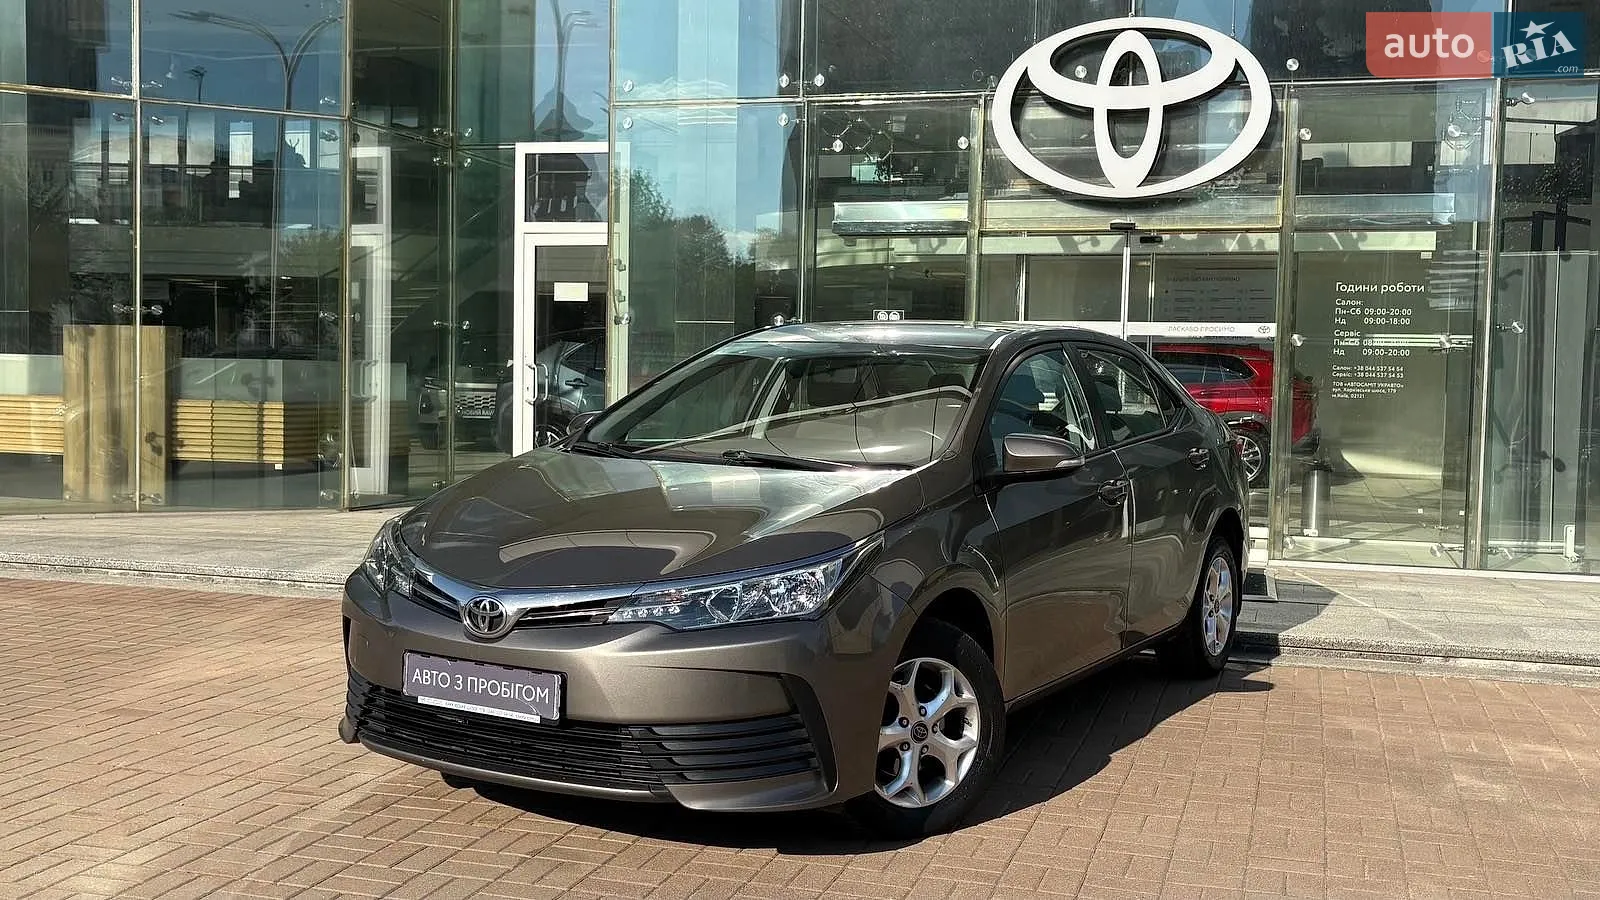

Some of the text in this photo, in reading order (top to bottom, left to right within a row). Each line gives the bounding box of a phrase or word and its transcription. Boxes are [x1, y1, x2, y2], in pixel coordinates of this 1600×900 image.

[1336, 282, 1425, 294] Години роботи
[1335, 298, 1364, 306] Салон:
[1335, 307, 1412, 316] Пн-Сб 09:00-20:00
[1334, 317, 1411, 325] Нд 09:00-18:00
[1333, 348, 1410, 356] Нд 09:00-20:00
[412, 668, 550, 704] АВТО З ПРОБІГОМ
